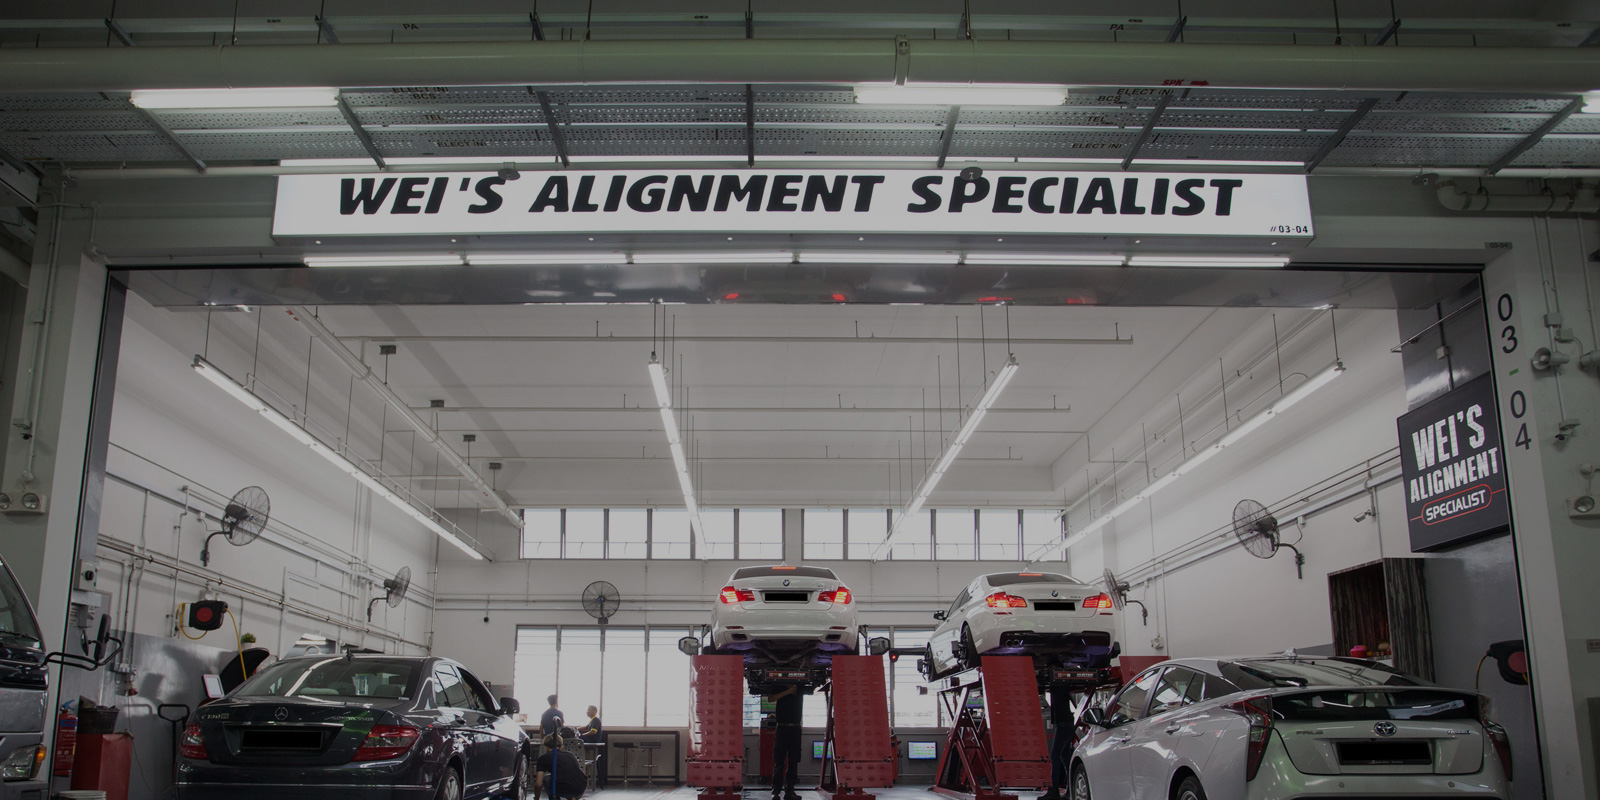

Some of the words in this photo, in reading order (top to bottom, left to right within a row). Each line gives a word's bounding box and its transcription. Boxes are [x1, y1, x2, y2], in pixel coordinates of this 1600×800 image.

[338, 177, 505, 216] WEI'S
[529, 174, 884, 214] ALIGNMENT
[907, 176, 1243, 217] SPECIALIST
[1411, 404, 1487, 471] WEI'S
[1409, 447, 1499, 504] ALIGNMENT
[1425, 489, 1487, 521] SPECIALIST
